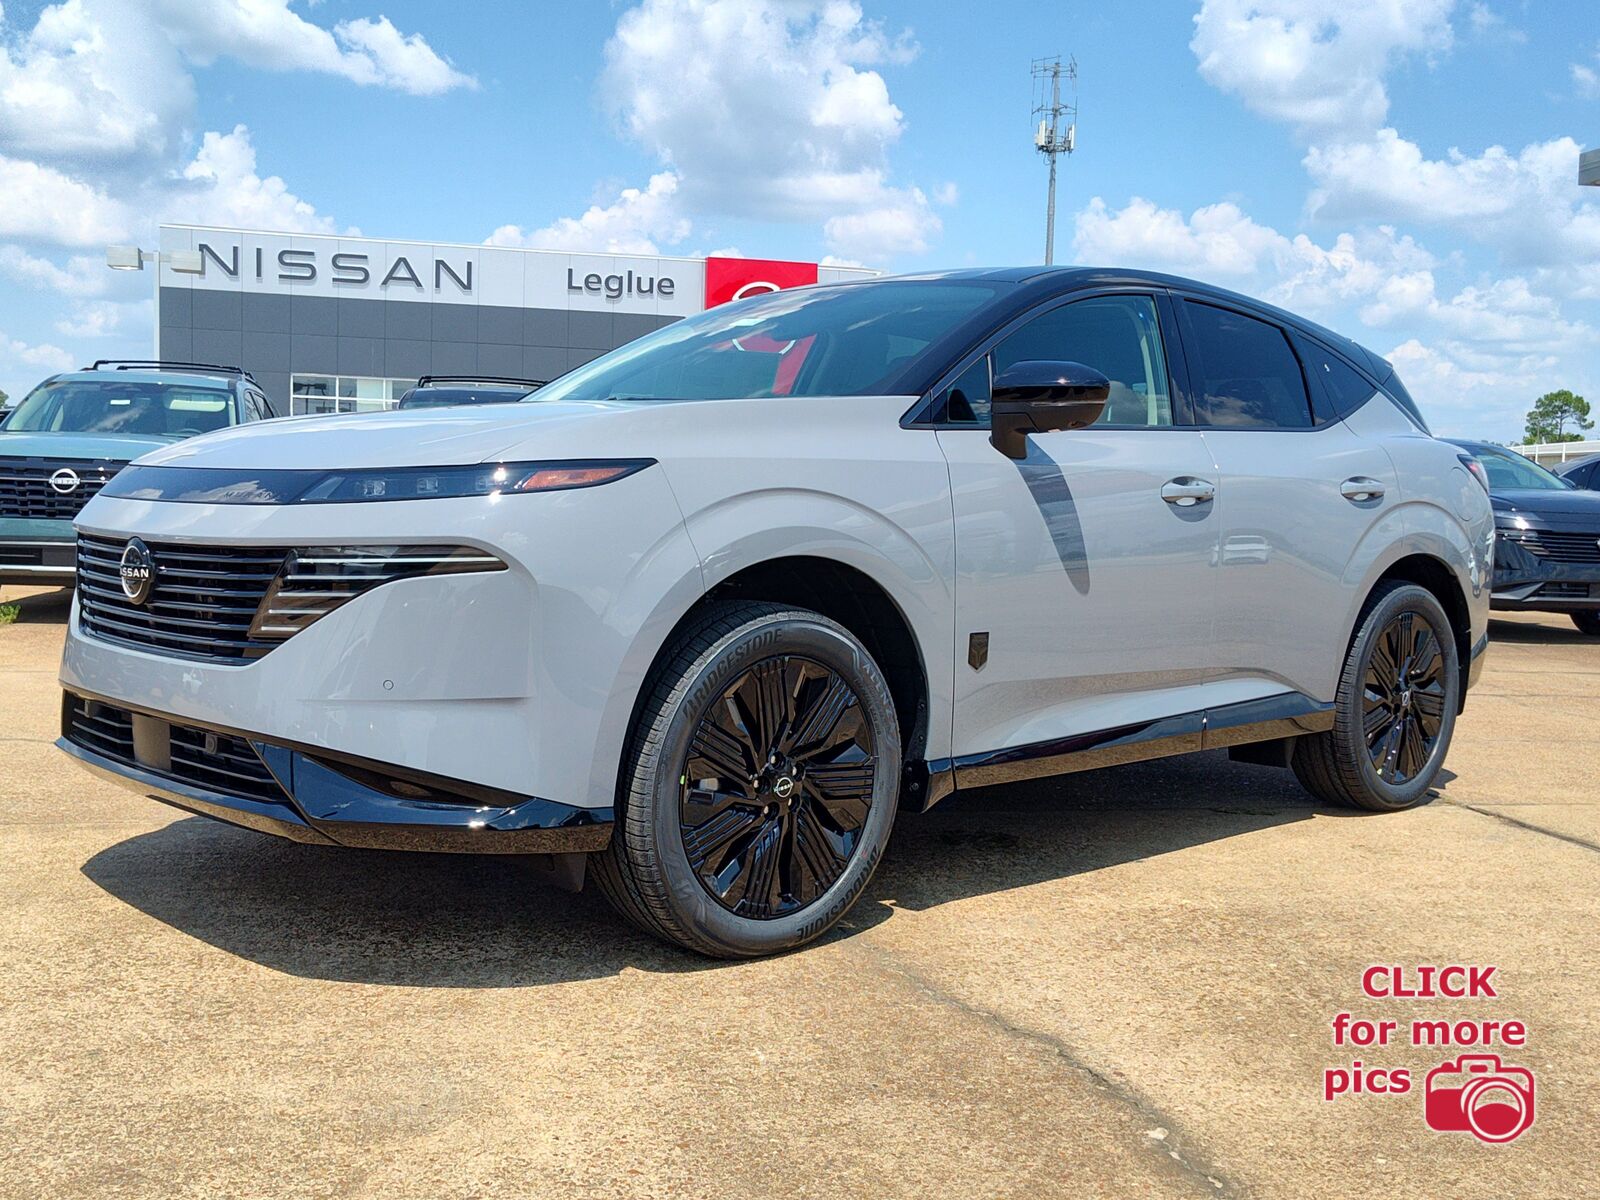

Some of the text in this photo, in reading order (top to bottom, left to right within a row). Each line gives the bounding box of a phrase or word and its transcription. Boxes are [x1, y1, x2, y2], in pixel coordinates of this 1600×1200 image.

[199, 243, 472, 291] NISSAN
[567, 267, 675, 299] Leglue
[120, 566, 149, 579] SSAN
